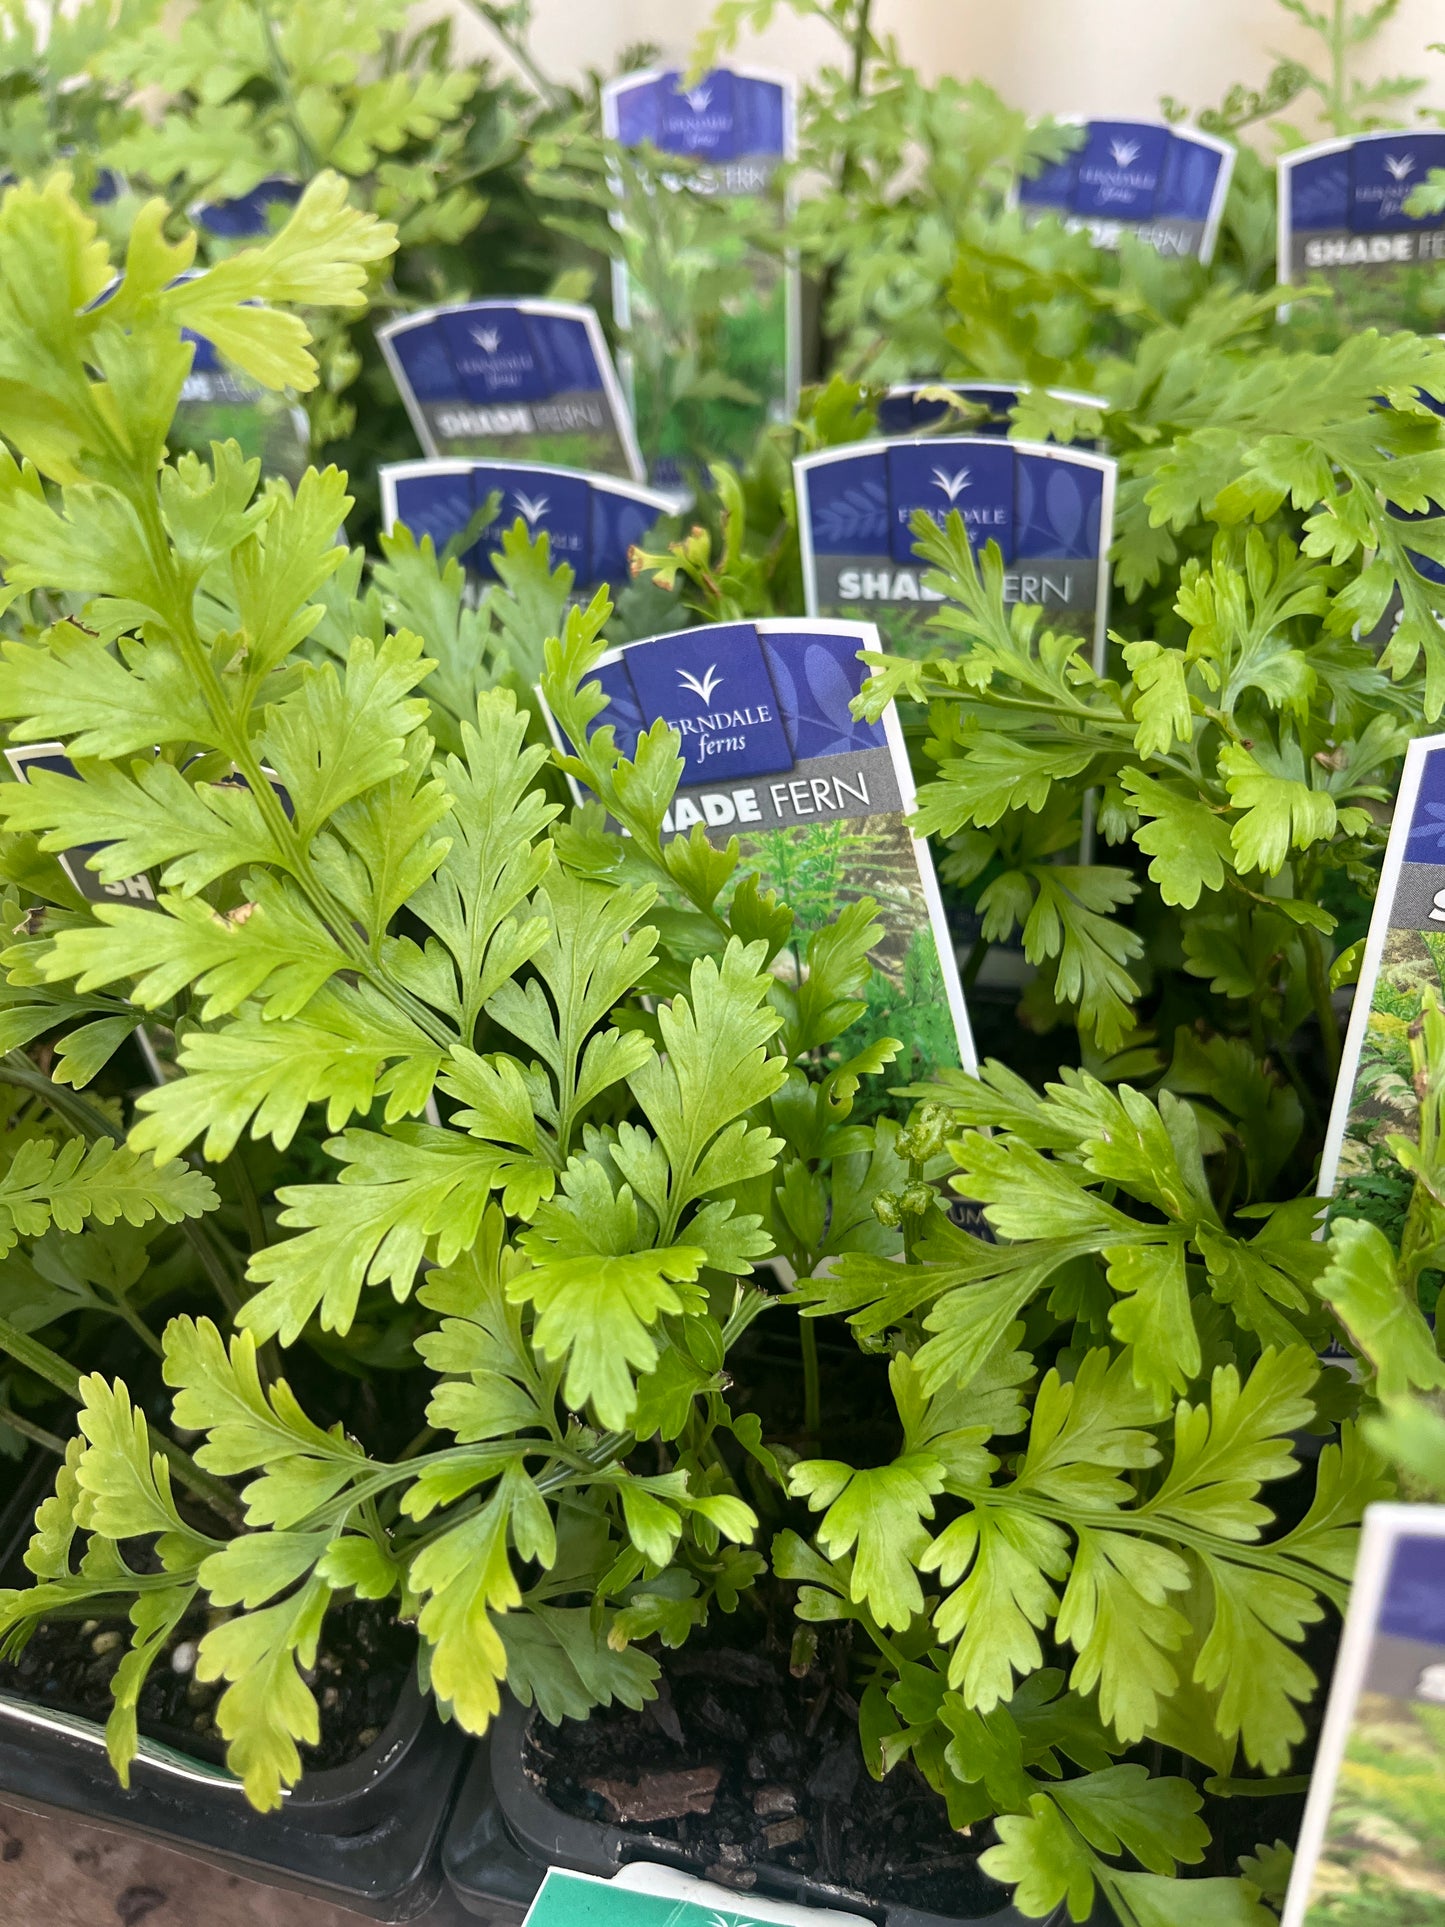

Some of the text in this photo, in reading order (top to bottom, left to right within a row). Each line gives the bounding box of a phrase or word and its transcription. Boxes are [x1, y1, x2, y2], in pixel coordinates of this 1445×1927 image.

[1304, 234, 1413, 266] SHADE
[838, 567, 1073, 603] SHA ERN
[667, 705, 773, 736] ERNDALE
[697, 733, 746, 764] ferns
[770, 772, 870, 818] FERN
